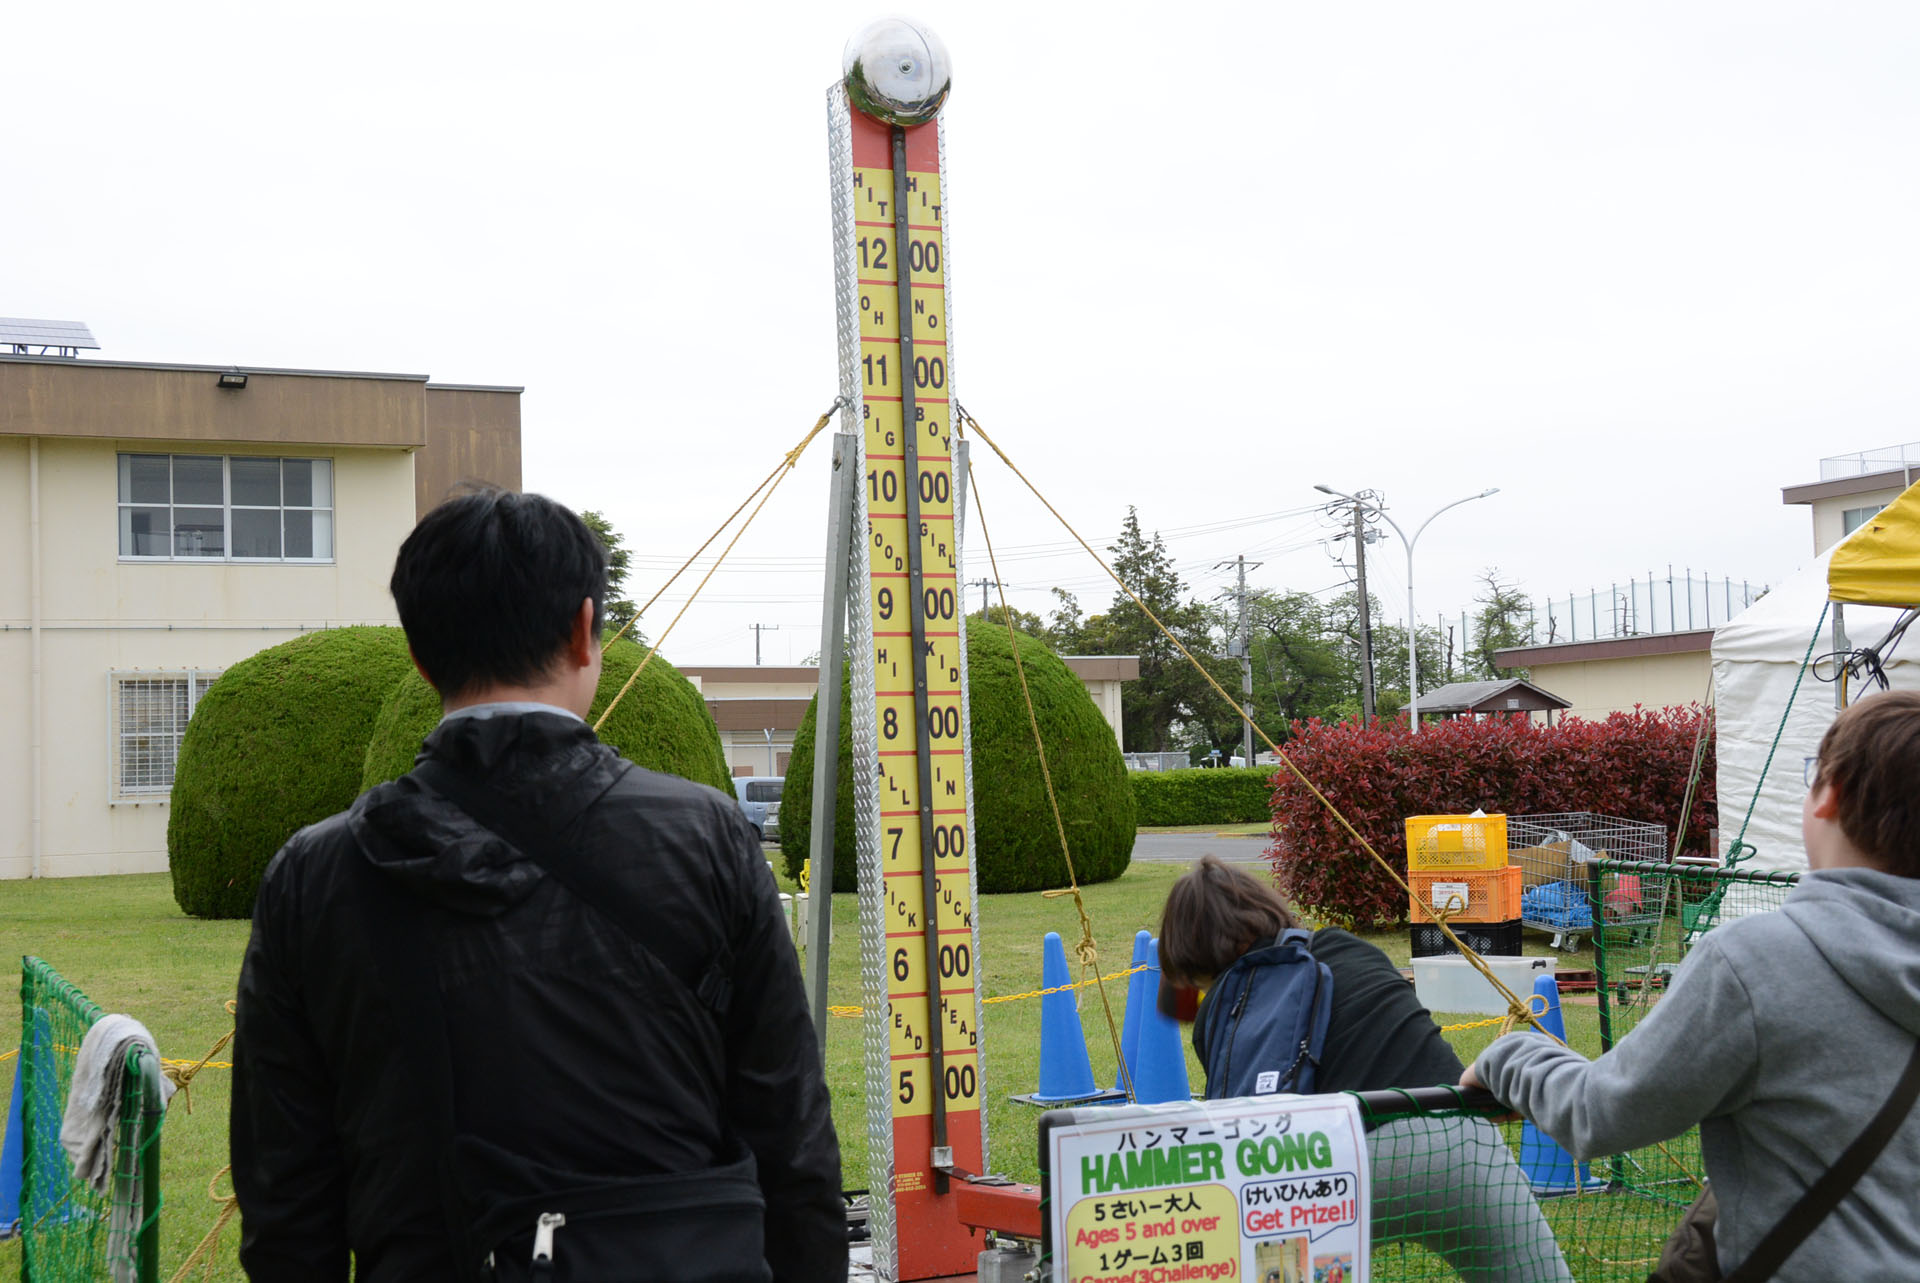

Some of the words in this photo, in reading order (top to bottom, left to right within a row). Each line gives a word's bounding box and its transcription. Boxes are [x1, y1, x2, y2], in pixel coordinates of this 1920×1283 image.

[853, 172, 888, 216] HIT
[906, 176, 941, 221] HIT
[857, 236, 888, 269] 12
[909, 239, 940, 273] 00
[860, 295, 884, 325] OH
[914, 299, 938, 328] NO
[862, 353, 887, 386] 11
[914, 355, 945, 389] 00
[863, 404, 895, 446] BIG
[915, 407, 950, 451] BOY
[867, 469, 897, 502] 10
[919, 470, 950, 503] 00
[920, 522, 956, 568] GIRL
[877, 587, 893, 620] 9
[924, 587, 955, 620] 00
[877, 648, 897, 677] HI
[925, 641, 958, 683] KID
[883, 706, 898, 740] 8
[928, 705, 959, 739] 00
[878, 762, 910, 805] ALL
[936, 767, 956, 795] IN
[887, 827, 903, 860] 7
[934, 824, 965, 858] 00
[936, 878, 971, 927] DUCK
[893, 947, 909, 981] 6
[939, 943, 970, 978] 00
[940, 998, 977, 1046] HEAD
[899, 1070, 914, 1104] 5
[945, 1063, 976, 1099] 00
[1117, 1112, 1293, 1151] ハンマーゴング
[1081, 1142, 1225, 1195] HAMMER
[1235, 1130, 1333, 1178] GONG
[1245, 1177, 1348, 1206] けいひんあり
[1075, 1226, 1120, 1249] Ages
[1125, 1222, 1137, 1242] 5
[1142, 1217, 1176, 1238] and
[1181, 1214, 1221, 1234] over
[1246, 1209, 1284, 1233] Get
[1290, 1199, 1356, 1228] Prize!!
